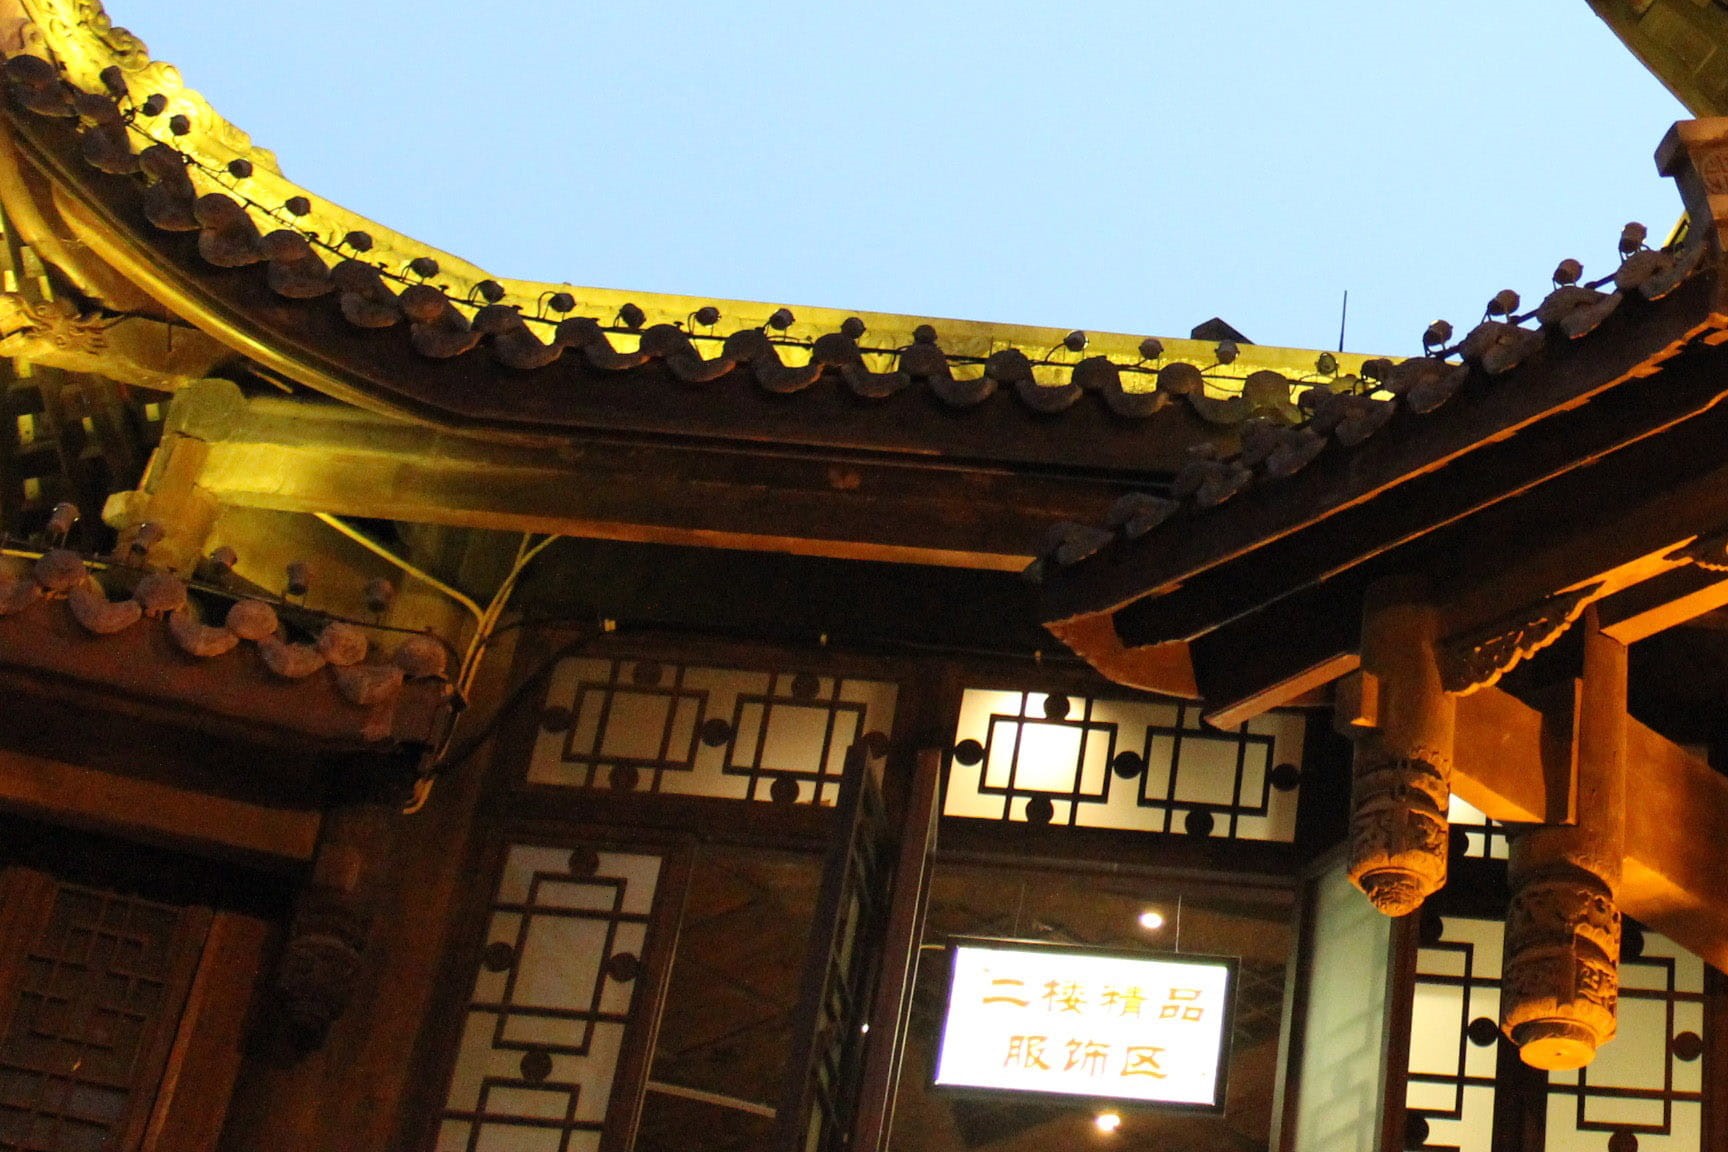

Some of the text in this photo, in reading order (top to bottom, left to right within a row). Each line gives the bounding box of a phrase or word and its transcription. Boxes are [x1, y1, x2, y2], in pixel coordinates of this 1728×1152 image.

[982, 978, 1205, 1022] 二楼精品
[1003, 1035, 1168, 1080] 服饰区
